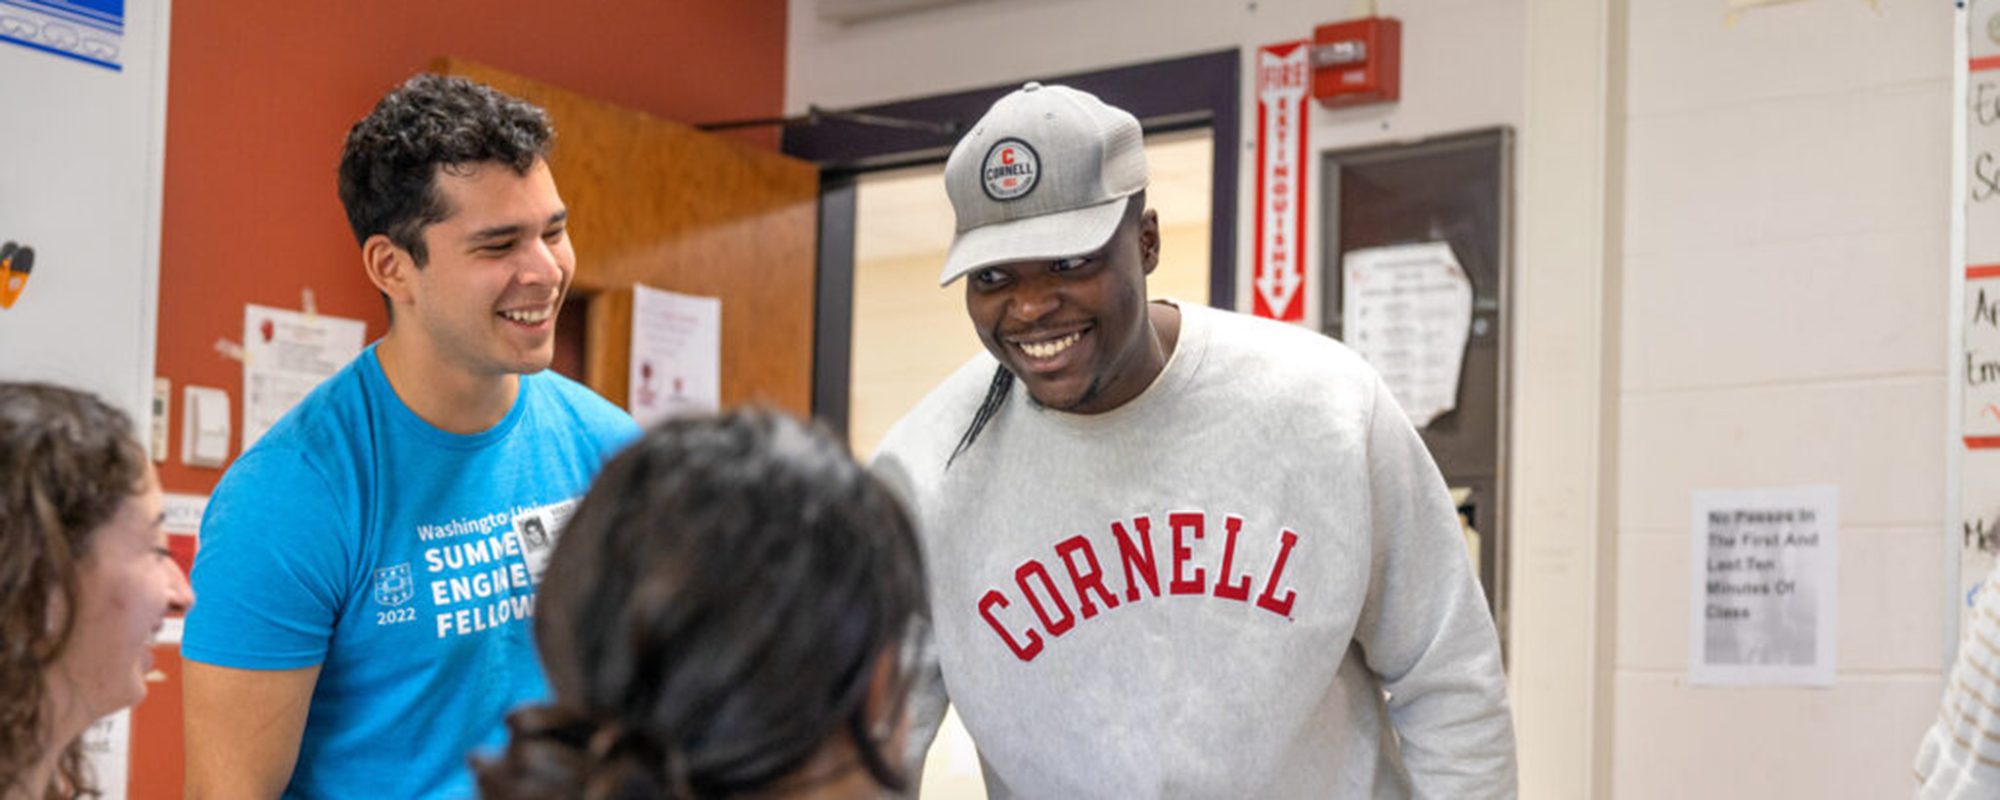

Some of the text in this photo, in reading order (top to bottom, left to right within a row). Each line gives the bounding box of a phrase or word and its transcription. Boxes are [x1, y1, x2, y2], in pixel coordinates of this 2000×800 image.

[1001, 147, 1015, 165] C
[986, 162, 1033, 181] CORNELL
[417, 514, 510, 542] Washingto
[1741, 533, 1779, 547] First
[1784, 532, 1819, 547] And
[424, 531, 519, 573] SUMME
[431, 563, 528, 606] ENGINE
[978, 513, 1298, 662] CORNELL
[376, 607, 417, 626] 2022
[436, 592, 535, 638] FELLOW
